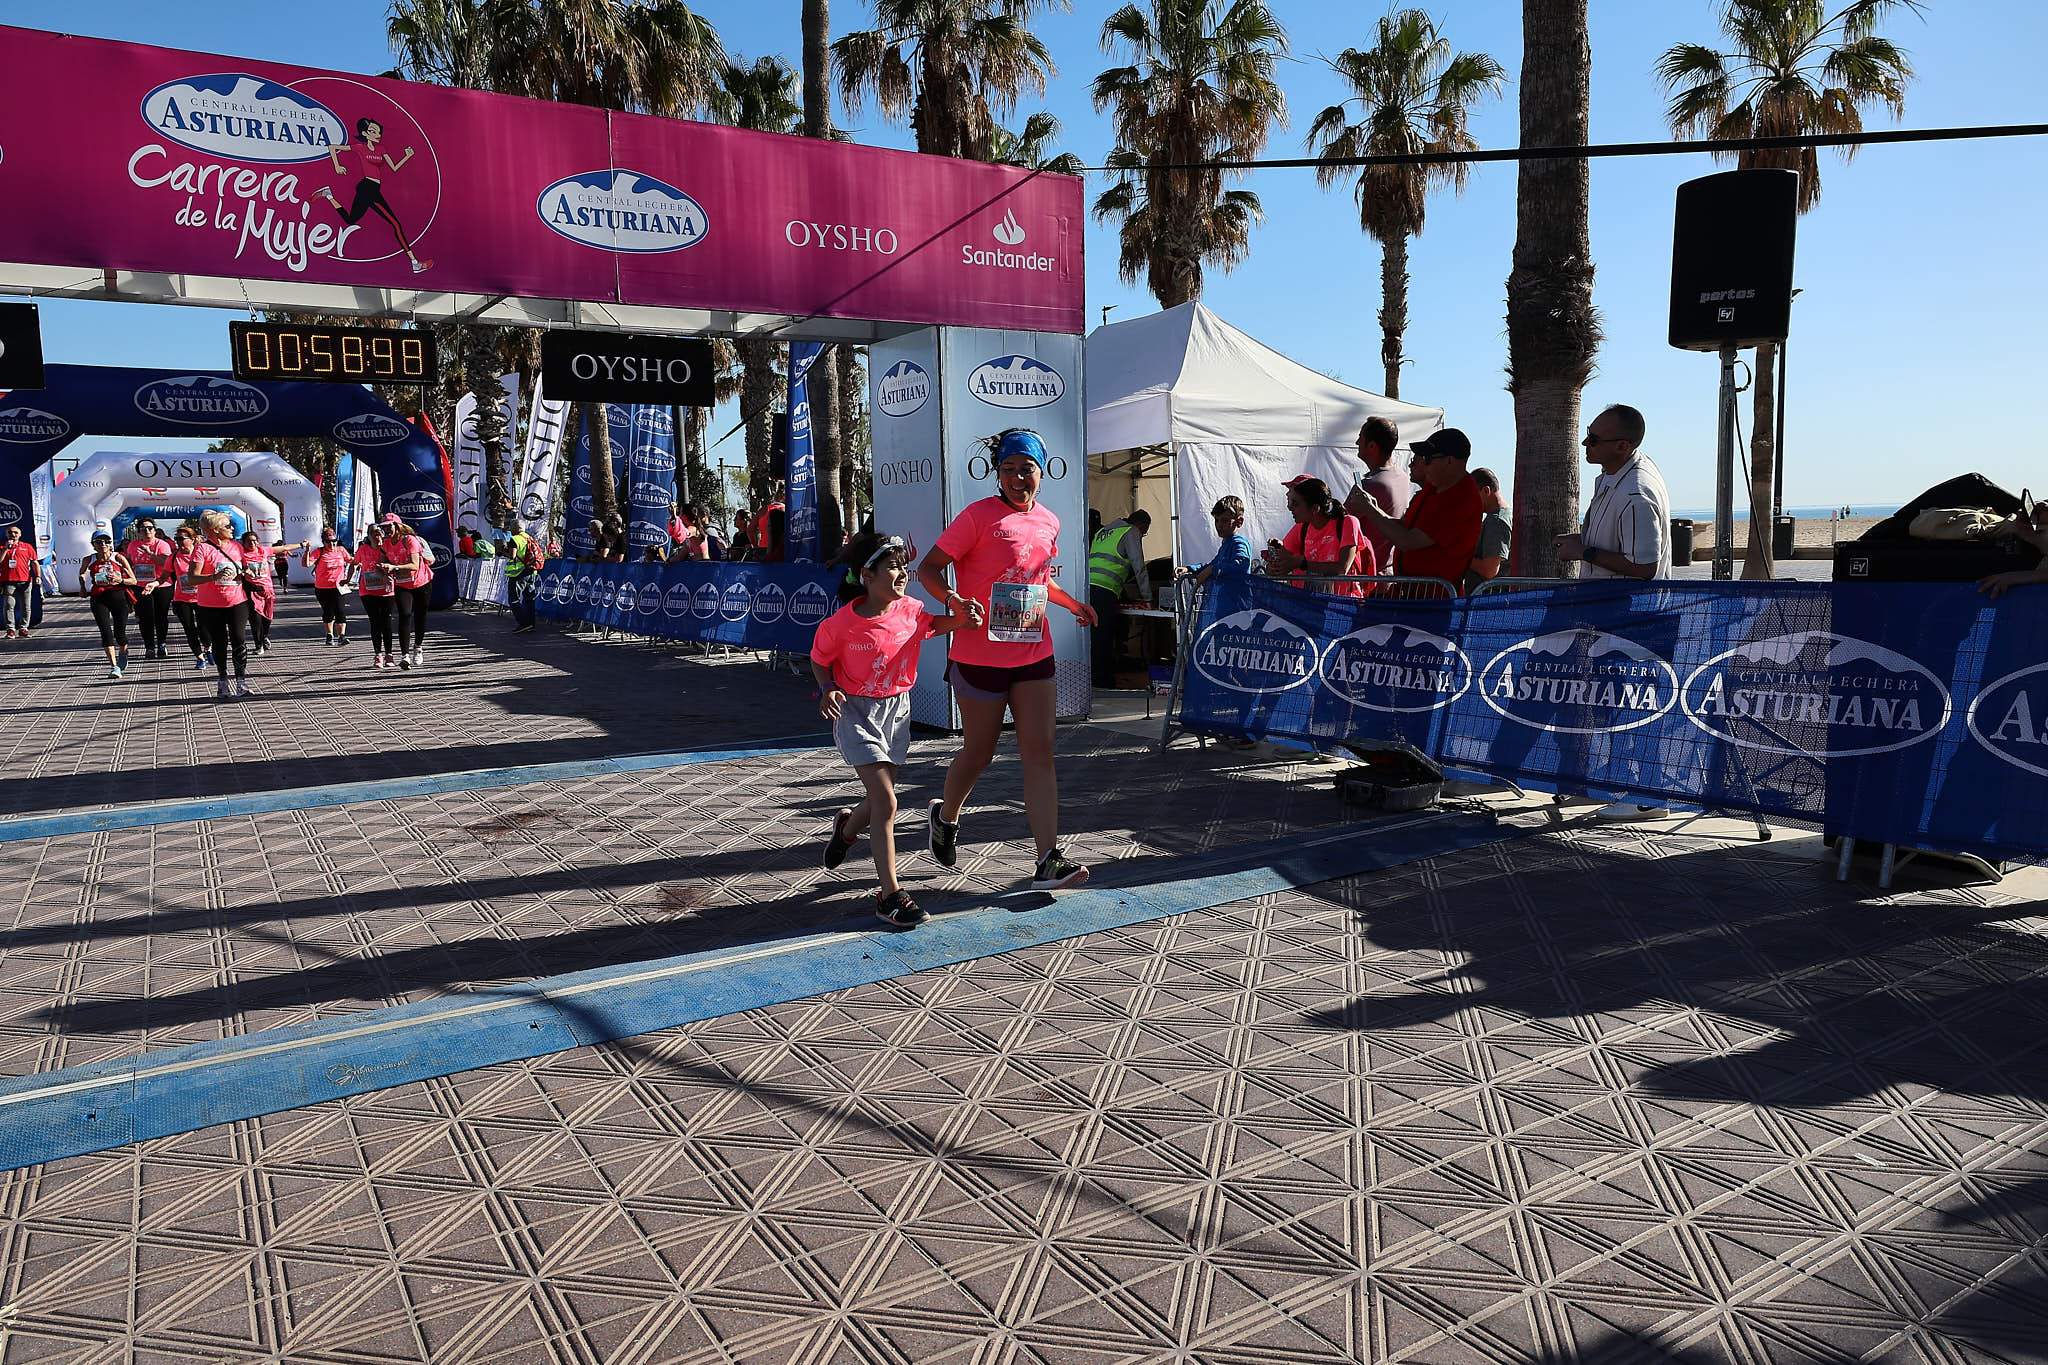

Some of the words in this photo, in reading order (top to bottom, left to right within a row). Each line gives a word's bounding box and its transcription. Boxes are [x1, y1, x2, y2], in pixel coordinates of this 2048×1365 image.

[160, 96, 332, 147] ASTURIANA
[190, 98, 256, 113] CENTRAL
[261, 107, 326, 122] LECHERA
[127, 144, 300, 203] Carrera
[552, 193, 697, 236] ASTURIANA
[578, 193, 632, 206] CENTRAL
[637, 200, 691, 213] LECHERA
[175, 196, 208, 227] de
[214, 197, 238, 231] la
[234, 199, 362, 272] Mujer
[785, 220, 898, 255] OYSHO
[962, 244, 1056, 272] Santander
[246, 332, 423, 375] 00:58:98
[571, 353, 691, 384] OYSHO
[989, 373, 1021, 381] CENTRAL
[165, 388, 209, 397] CENTRAL
[880, 383, 927, 407] ASTURIANA
[975, 374, 1058, 397] ASTURIANA
[145, 389, 260, 414] ASTURIANA
[340, 426, 405, 439] ASTURIANA
[135, 459, 242, 478] OYSHO
[881, 457, 933, 487] OYSHO
[69, 480, 104, 488] OYSHO
[271, 479, 302, 487] OYSHO
[57, 519, 90, 528] OYSHO
[290, 515, 318, 523] OYSHO
[722, 596, 749, 612] ASTURIANA
[754, 597, 783, 614] ASTURIANA
[791, 597, 826, 616] ASTURIANA
[1222, 634, 1261, 646] CENTRAL
[1264, 638, 1306, 651] LECHERA
[1200, 634, 1306, 676] ASTURIANA
[1405, 653, 1456, 666] LECHERA
[1328, 647, 1457, 693] ASTURIANA
[1524, 661, 1584, 674] CENTRAL
[1588, 664, 1657, 677] LECHERA
[1490, 661, 1662, 711] ASTURIANA
[1739, 671, 1827, 686] CENTRAL
[1828, 675, 1921, 691] LECHERA
[1694, 671, 1924, 732] ASTURIANA
